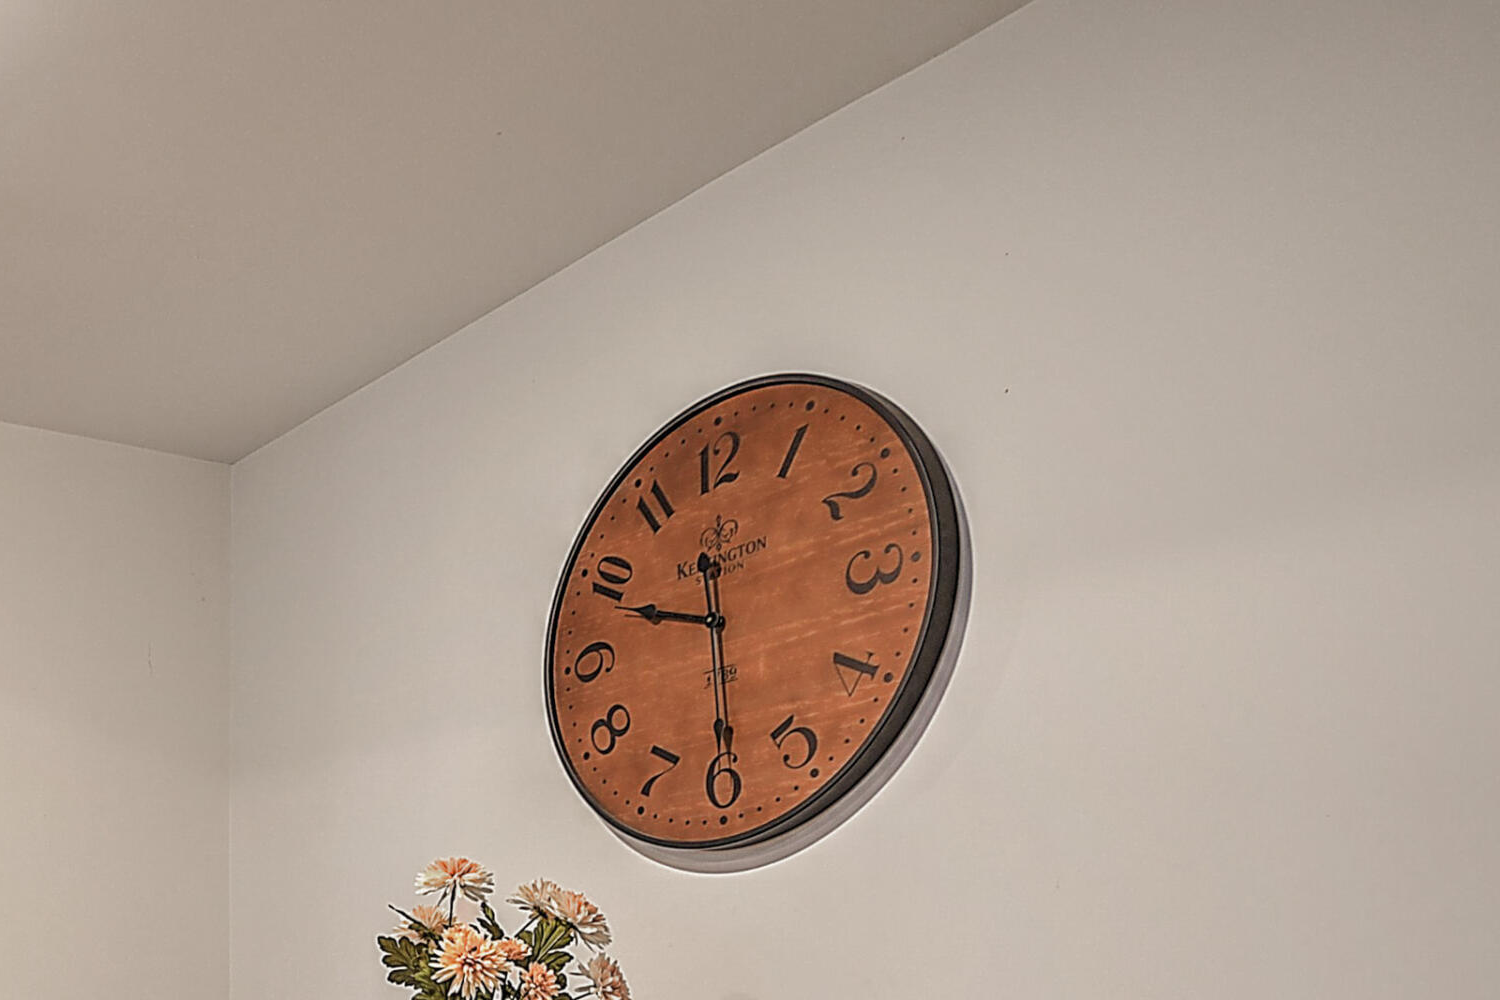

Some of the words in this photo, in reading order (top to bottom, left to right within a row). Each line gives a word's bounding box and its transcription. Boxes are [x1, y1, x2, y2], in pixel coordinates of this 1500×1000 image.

[698, 431, 741, 496] 12
[776, 423, 810, 479] 1
[636, 479, 675, 534] 11
[821, 462, 878, 521] 2
[592, 556, 633, 602] 10
[676, 536, 767, 580] KEINGTON
[845, 543, 904, 595] 3
[574, 641, 616, 683] 9
[833, 651, 880, 697] 4
[590, 704, 631, 755] 8
[769, 714, 818, 769] 5
[640, 745, 680, 797] 7
[706, 751, 741, 809] 6
